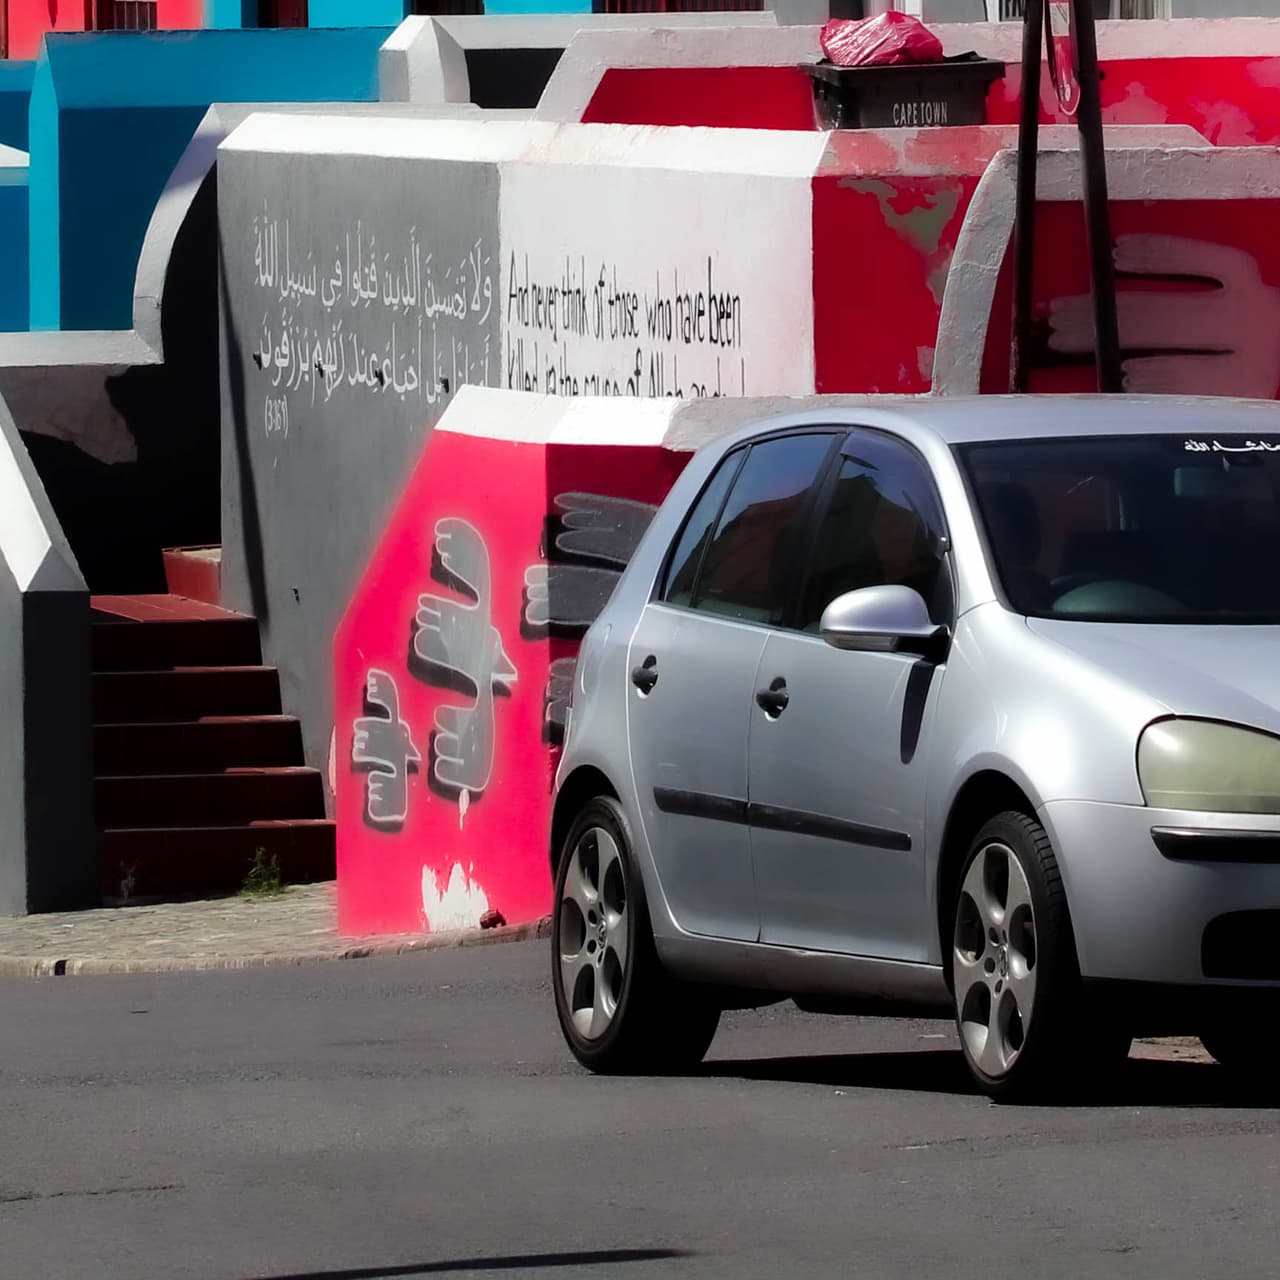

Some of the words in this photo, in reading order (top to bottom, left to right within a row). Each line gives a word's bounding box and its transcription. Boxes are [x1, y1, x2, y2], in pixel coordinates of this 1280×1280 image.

[892, 102, 919, 126] CAPE
[920, 101, 948, 124] TOWN
[507, 248, 530, 327] And
[532, 282, 561, 343] never
[561, 254, 590, 337] think
[592, 259, 607, 341] of
[608, 263, 640, 340] those
[644, 268, 672, 343] who
[674, 266, 706, 345] have
[707, 255, 742, 349] been
